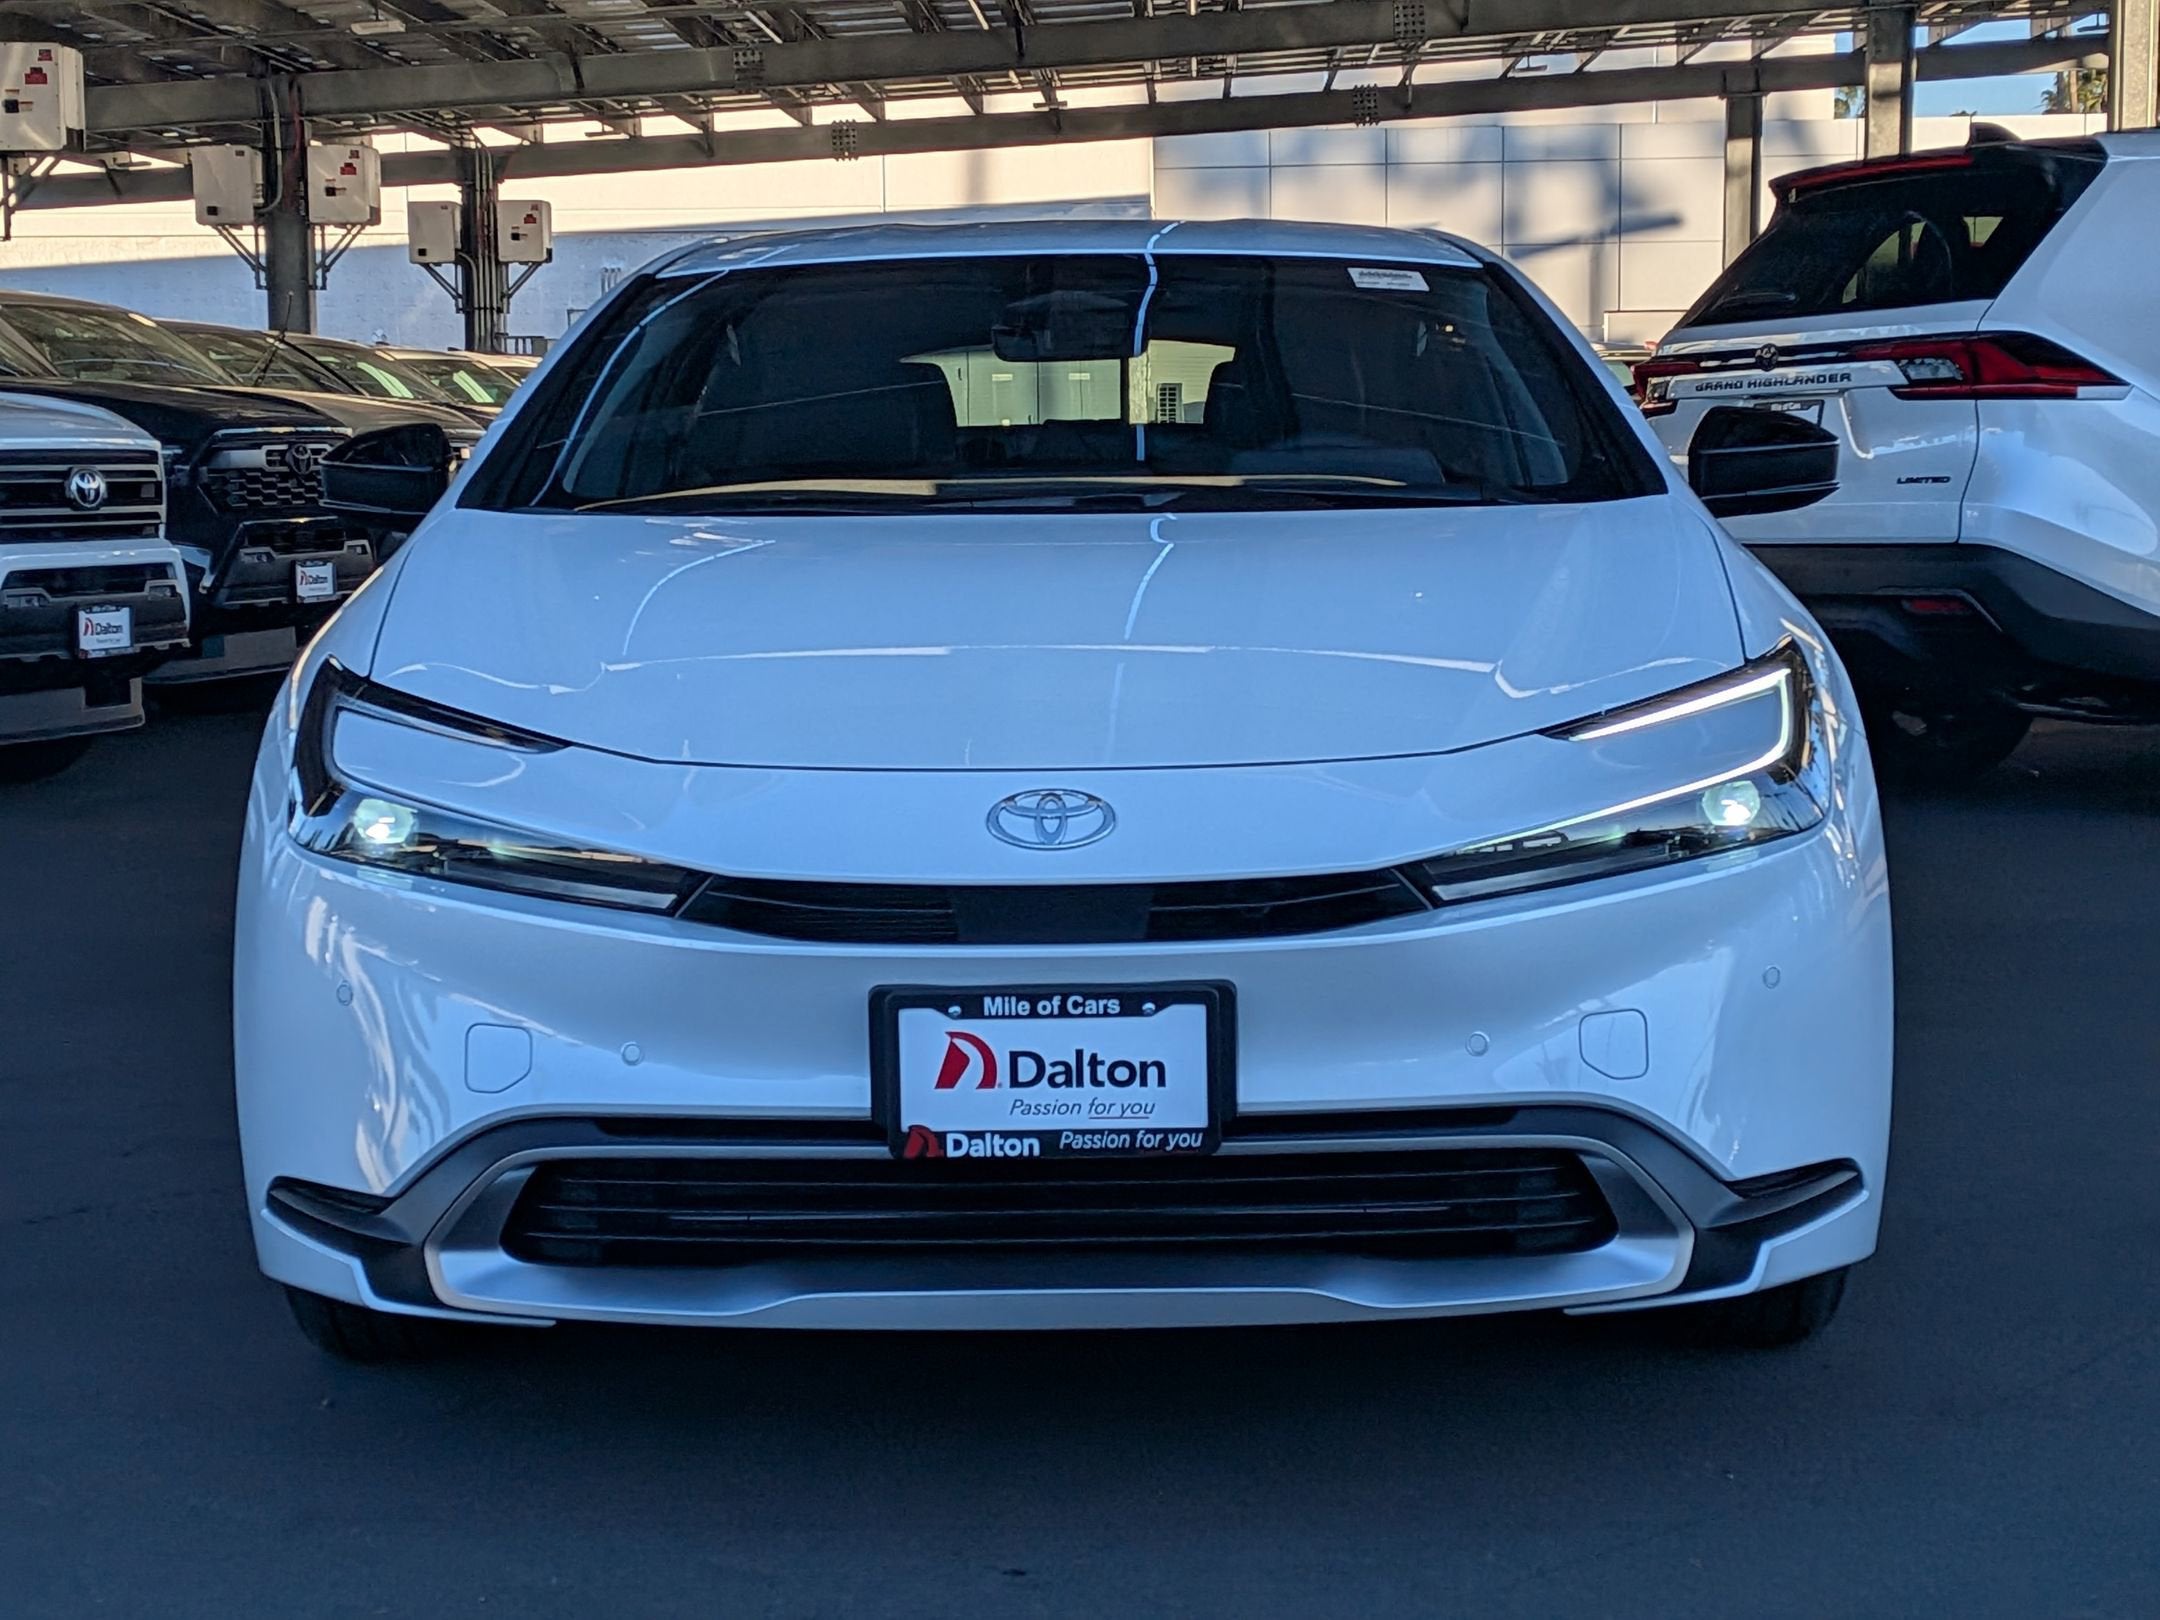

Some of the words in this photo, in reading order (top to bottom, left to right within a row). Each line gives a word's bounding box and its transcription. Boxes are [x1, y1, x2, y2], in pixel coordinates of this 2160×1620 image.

[1694, 380, 1743, 392] GRAND
[1747, 373, 1852, 389] HIGHLANDER
[983, 996, 1031, 1016] Mile
[1037, 995, 1062, 1015] of
[1066, 995, 1121, 1015] Cars
[1008, 1048, 1167, 1089] Dalton
[1009, 1098, 1082, 1116] Passion
[1088, 1097, 1117, 1116] for
[1120, 1101, 1156, 1118] you
[946, 1132, 1041, 1158] Dalton
[1059, 1131, 1131, 1149] Passion
[1135, 1130, 1165, 1148] for
[1165, 1132, 1204, 1151] you
